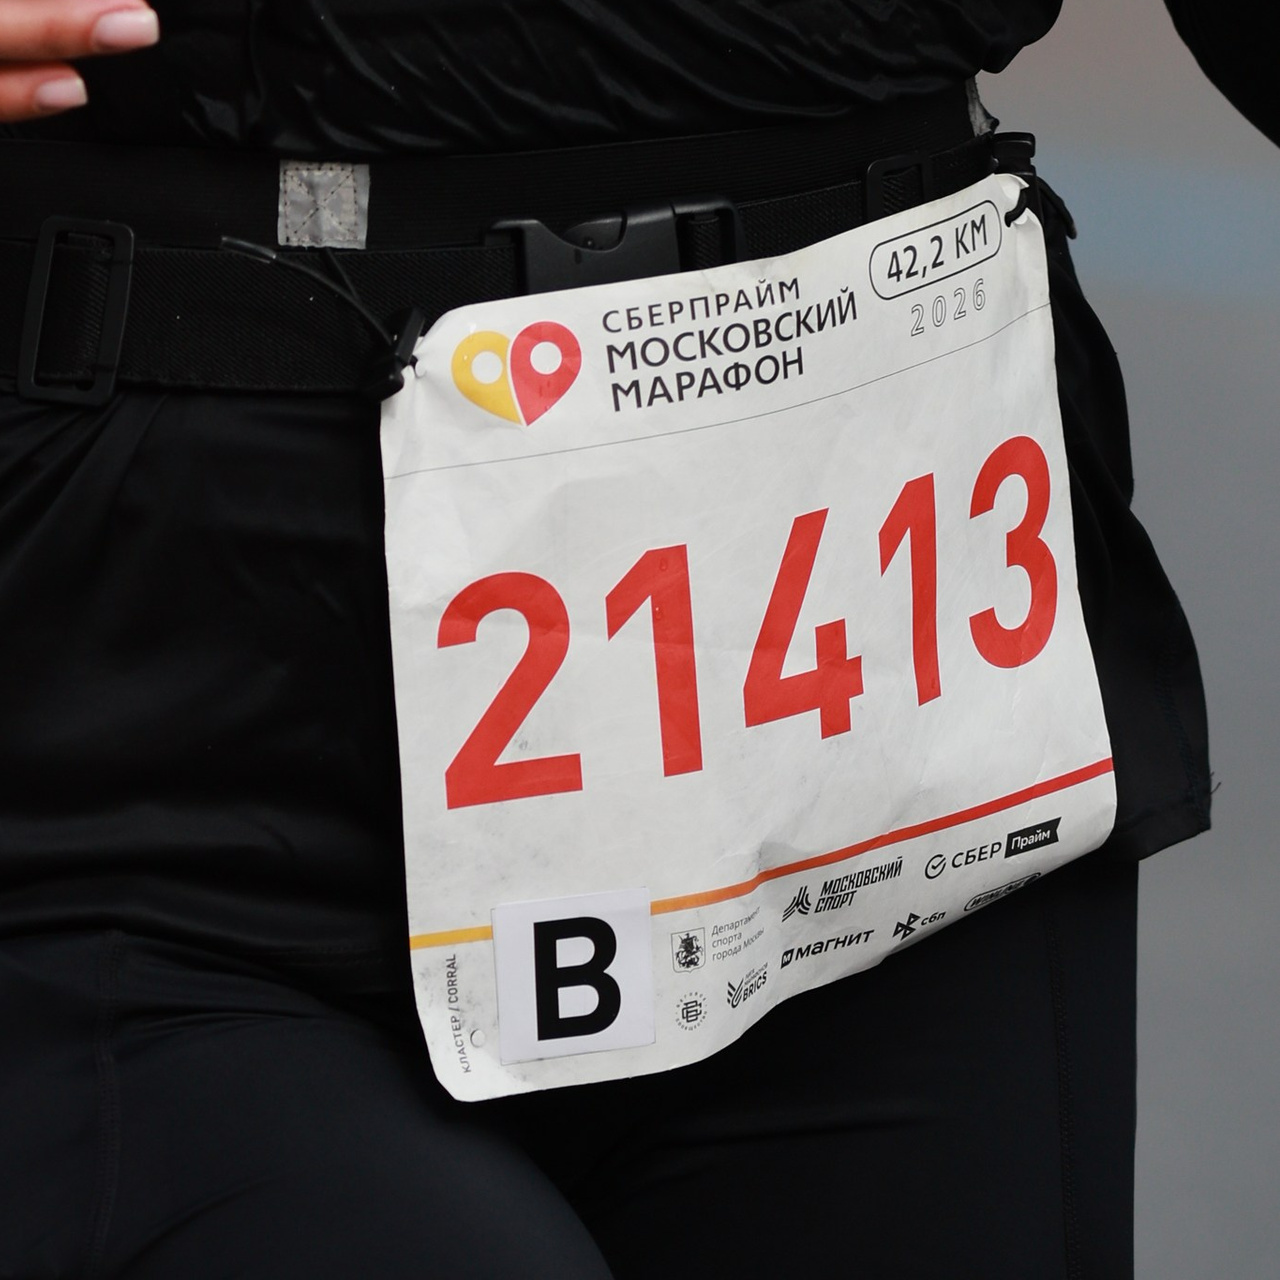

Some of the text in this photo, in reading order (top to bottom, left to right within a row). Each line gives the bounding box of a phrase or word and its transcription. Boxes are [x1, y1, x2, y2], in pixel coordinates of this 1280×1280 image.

[886, 235, 944, 285] 42,2
[602, 277, 801, 334] СБЕРПРАЙМ
[910, 278, 987, 338] 2026
[605, 286, 858, 374] МОСКОВСКИЙ
[610, 348, 805, 413] МАРАФОН
[436, 435, 1058, 810] 21413
[951, 828, 1051, 870] СБЕР Прайм
[820, 856, 904, 897] МОСКОВСКИЙ
[711, 906, 760, 937] Департамент
[814, 891, 857, 914] СПОРТ
[921, 911, 947, 927] сбп
[711, 932, 742, 949] спорта
[712, 944, 742, 961] города
[446, 953, 459, 1004] CORRAL
[742, 971, 767, 1002] BRICS
[450, 1015, 472, 1074] КЛАСТЕР
